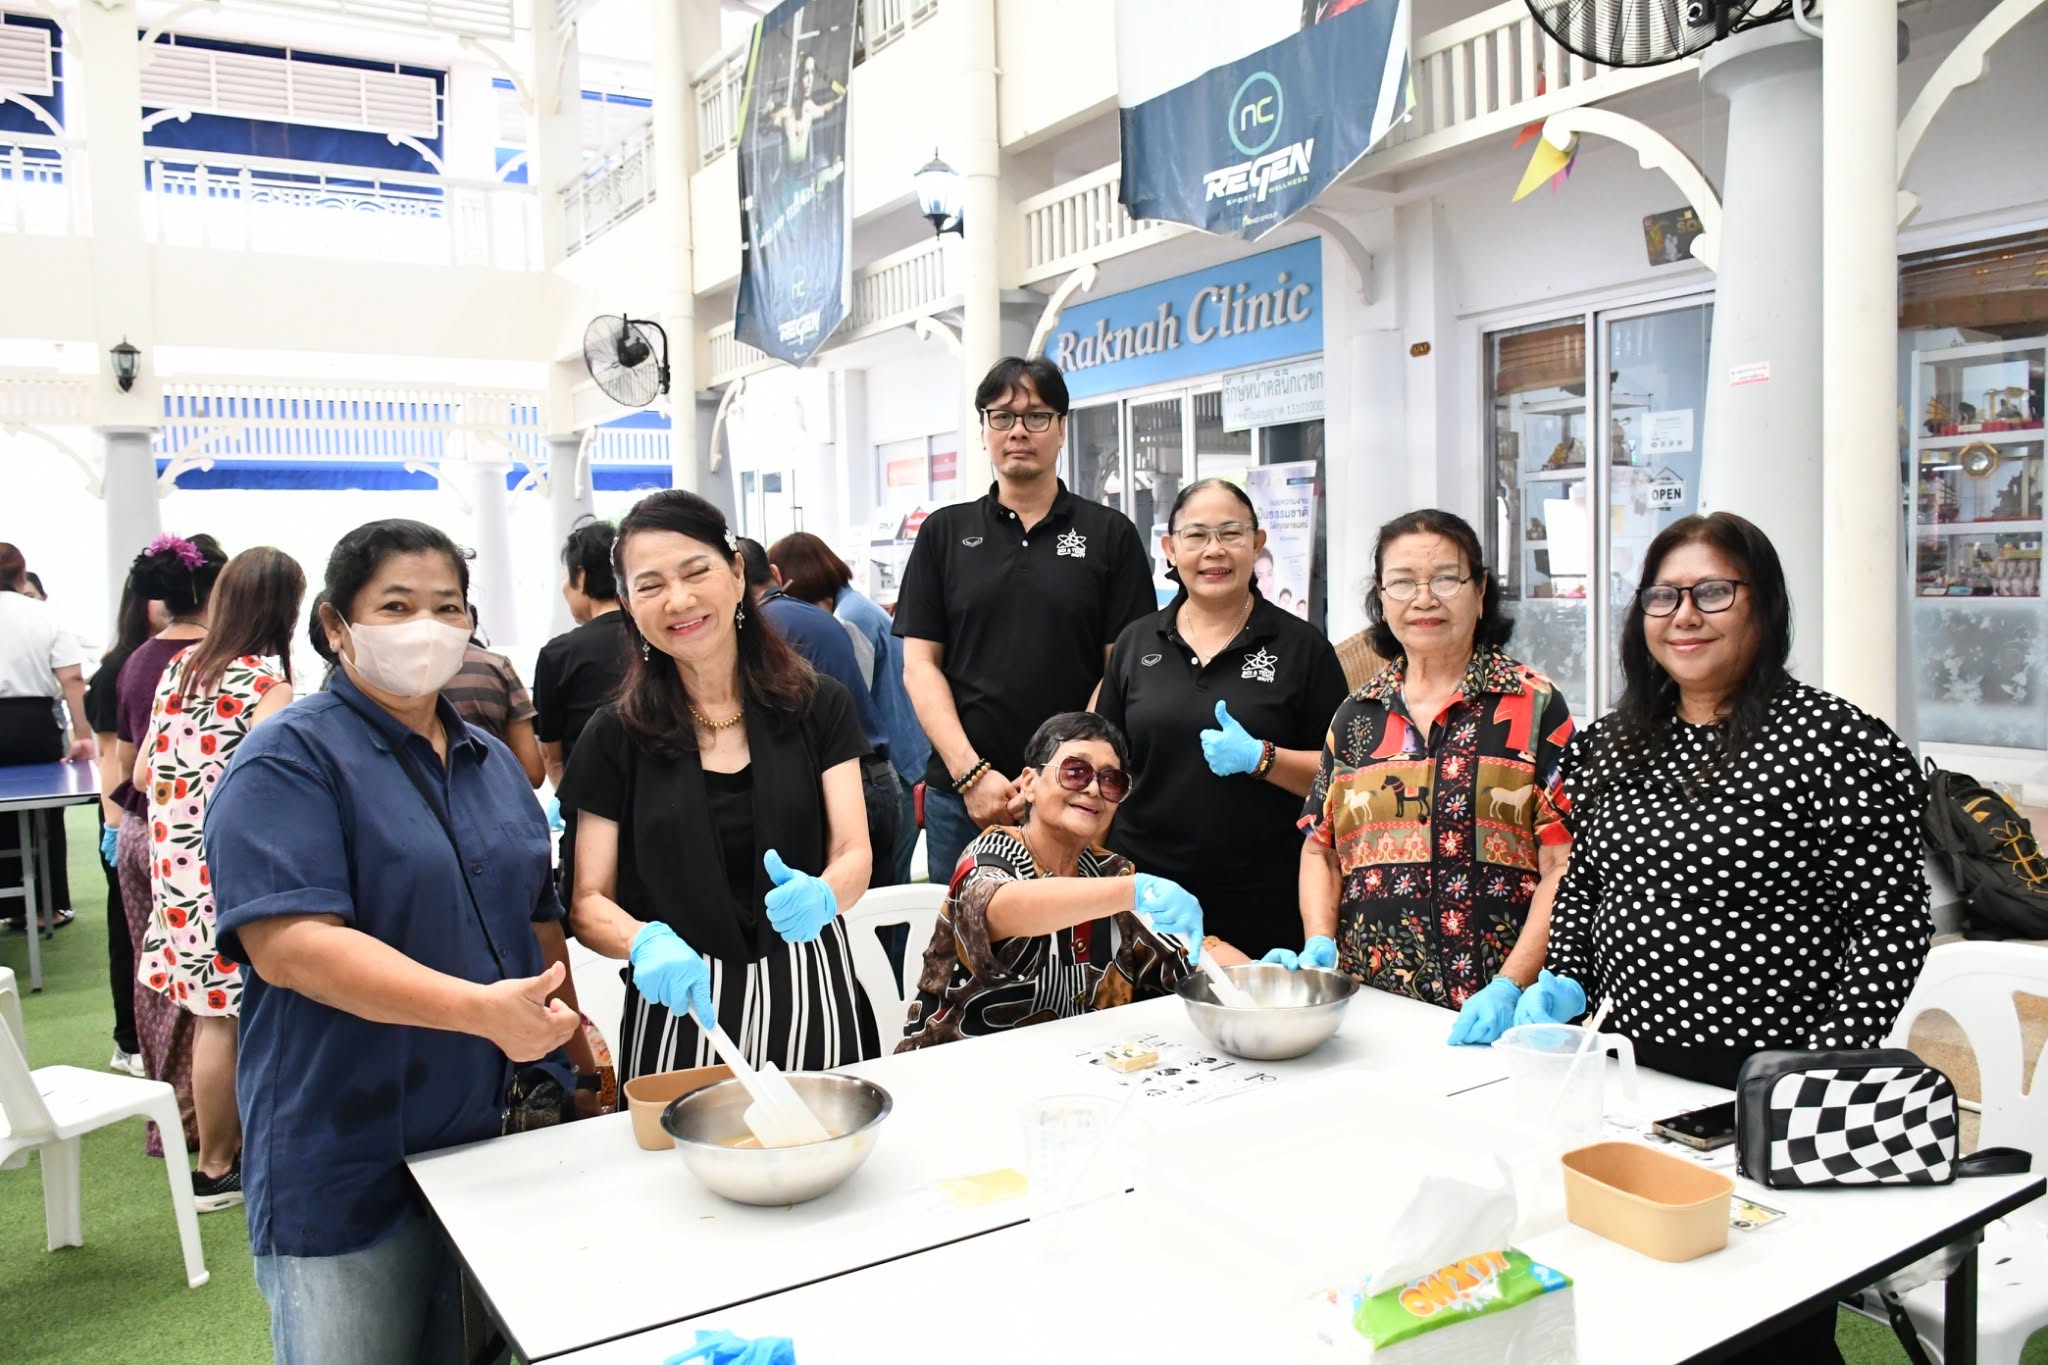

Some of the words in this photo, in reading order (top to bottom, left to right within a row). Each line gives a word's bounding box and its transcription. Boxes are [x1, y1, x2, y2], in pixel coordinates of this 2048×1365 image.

[1268, 174, 1309, 193] WELLNESS
[1056, 302, 1182, 373] Raknah
[1186, 271, 1312, 345] Clinic
[1651, 487, 1682, 501] OPEN
